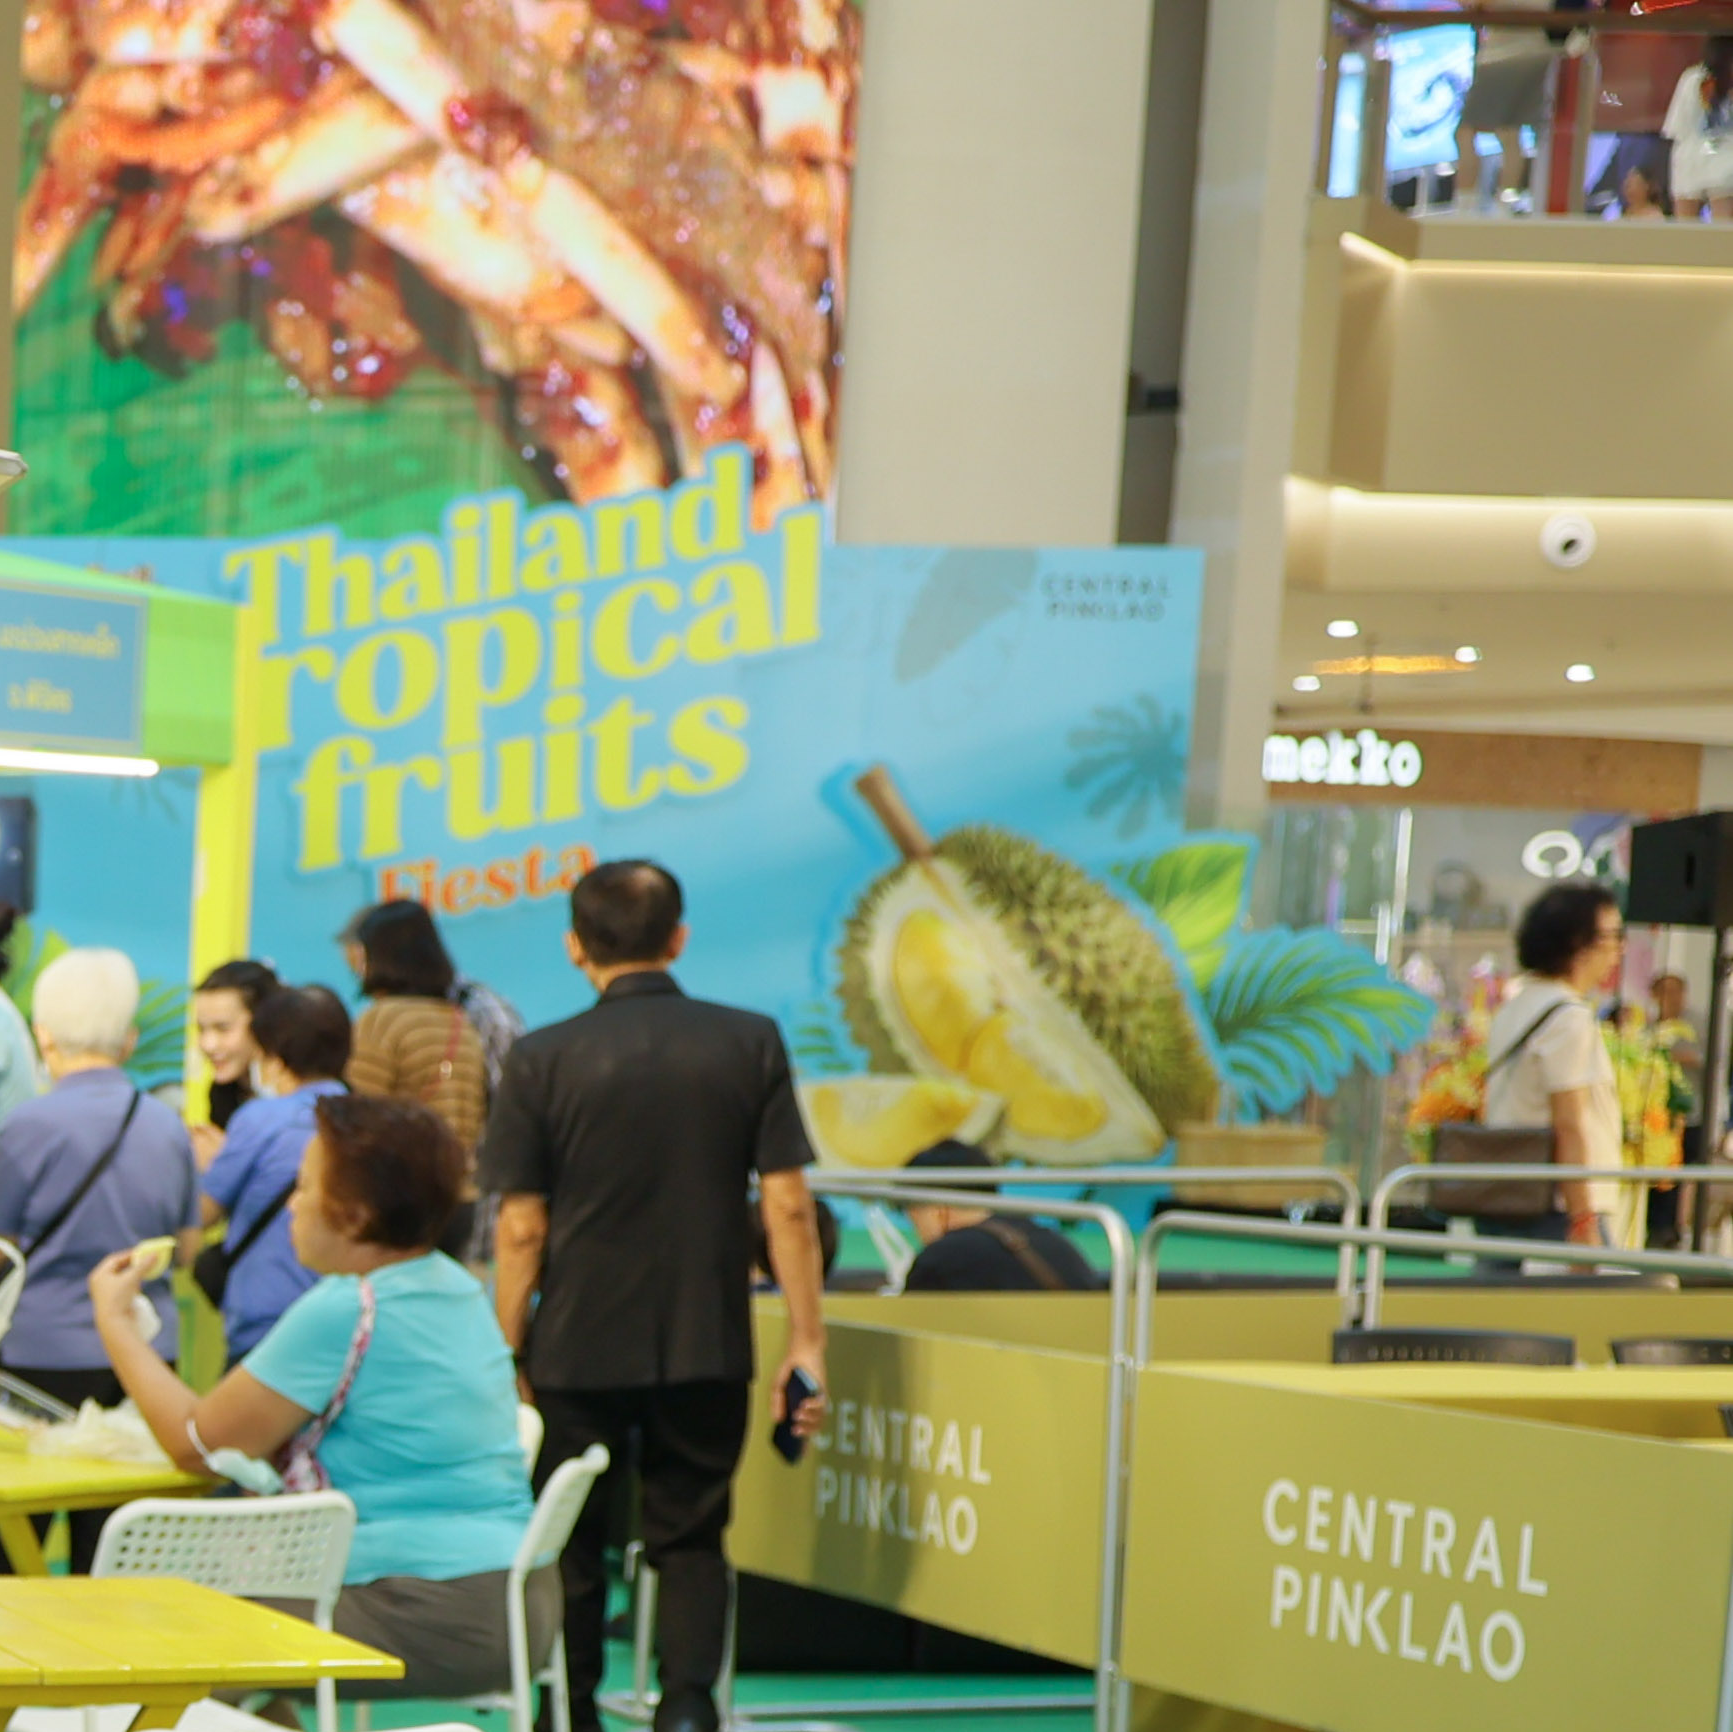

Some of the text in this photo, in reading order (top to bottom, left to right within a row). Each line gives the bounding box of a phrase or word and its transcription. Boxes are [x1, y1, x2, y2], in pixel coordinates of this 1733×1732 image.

[224, 451, 749, 643] Thailand
[257, 513, 821, 751] ropical
[291, 694, 749, 871] fruits
[1262, 729, 1423, 787] mekko
[377, 843, 597, 916] Fiesta
[816, 1466, 977, 1554] PINKLAO
[1263, 1477, 1548, 1597] CENTRAL
[1270, 1565, 1525, 1682] PINKLAO
